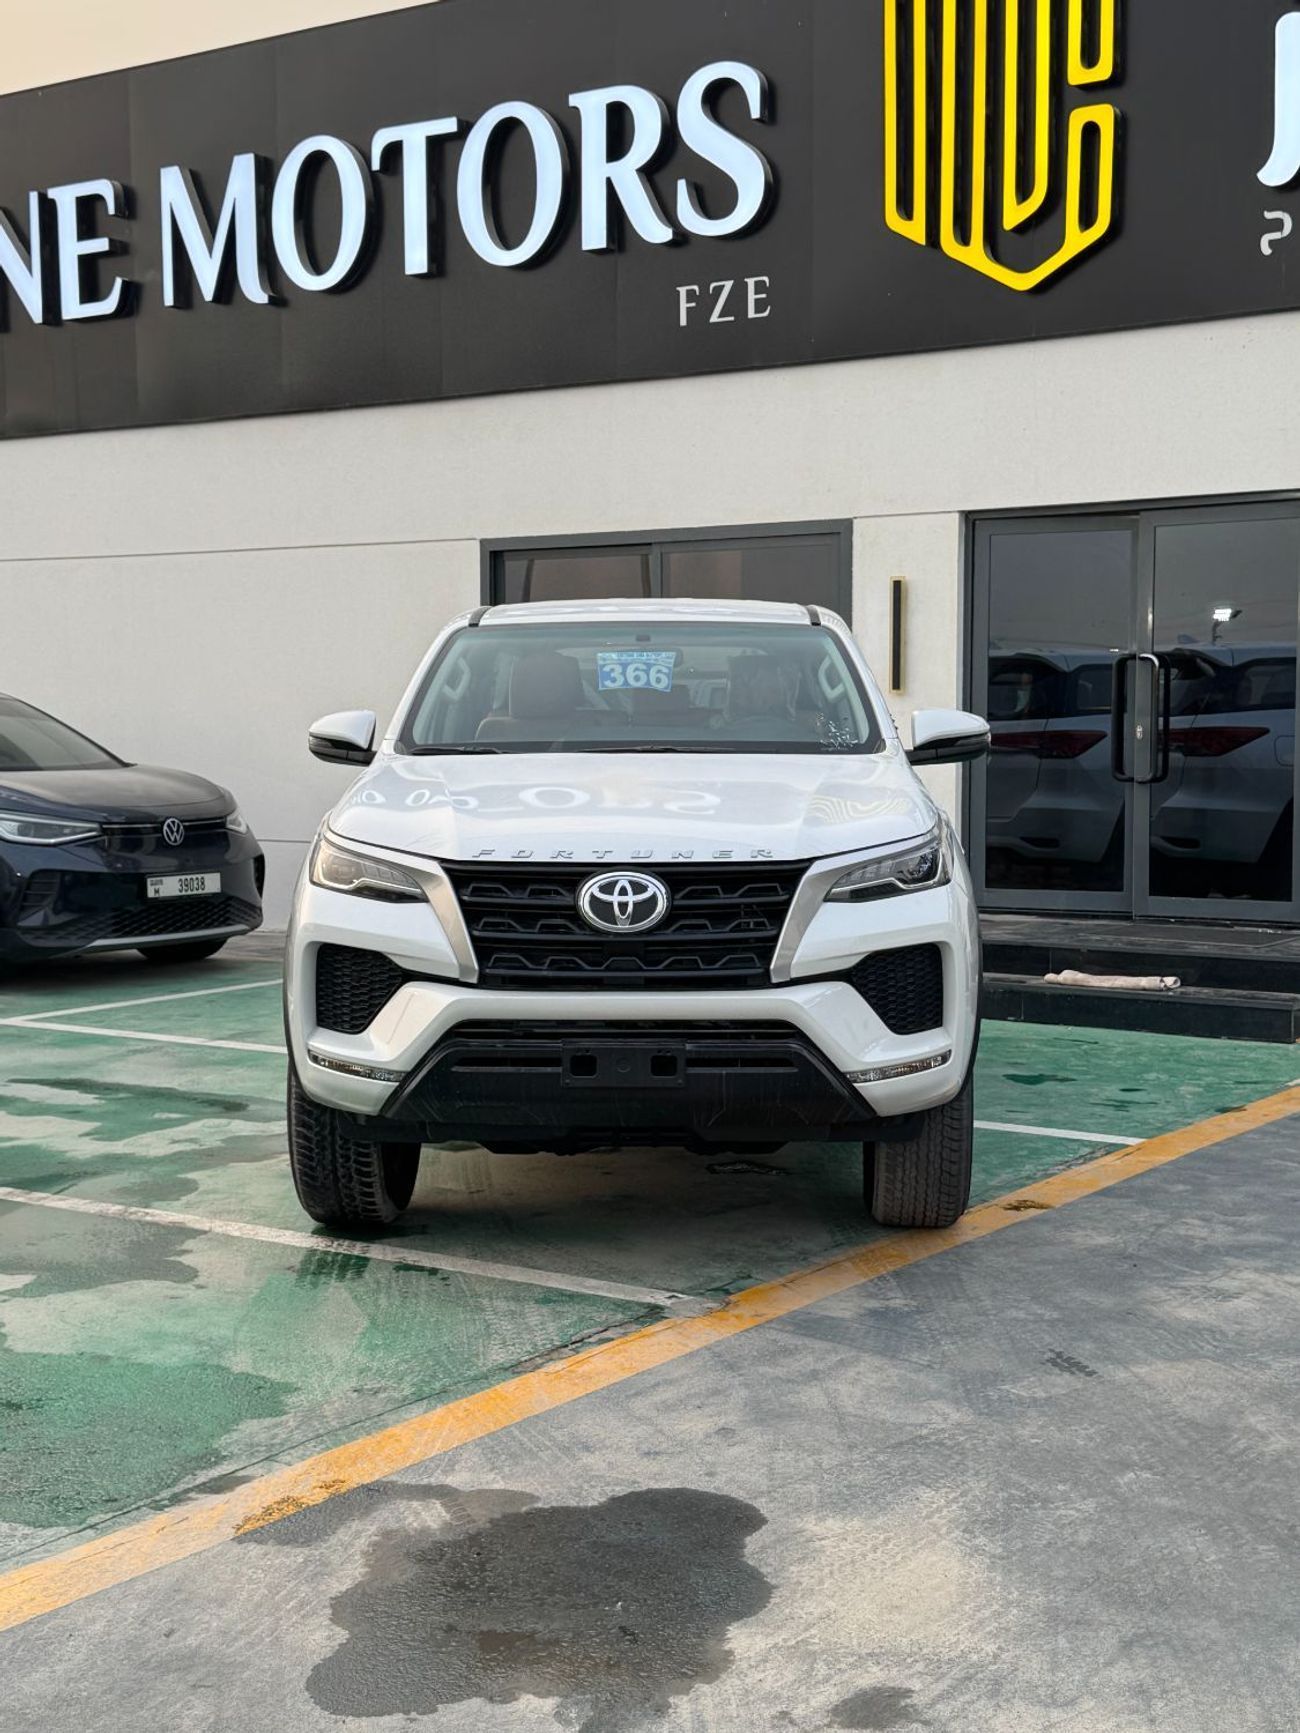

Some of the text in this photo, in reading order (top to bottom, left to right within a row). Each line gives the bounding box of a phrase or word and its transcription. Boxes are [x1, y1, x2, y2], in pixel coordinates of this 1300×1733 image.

[161, 60, 768, 307] MOTORS
[676, 276, 771, 327] FZE
[602, 663, 669, 689] 366
[472, 849, 774, 859] FORTUNER
[178, 876, 205, 893] 39038
